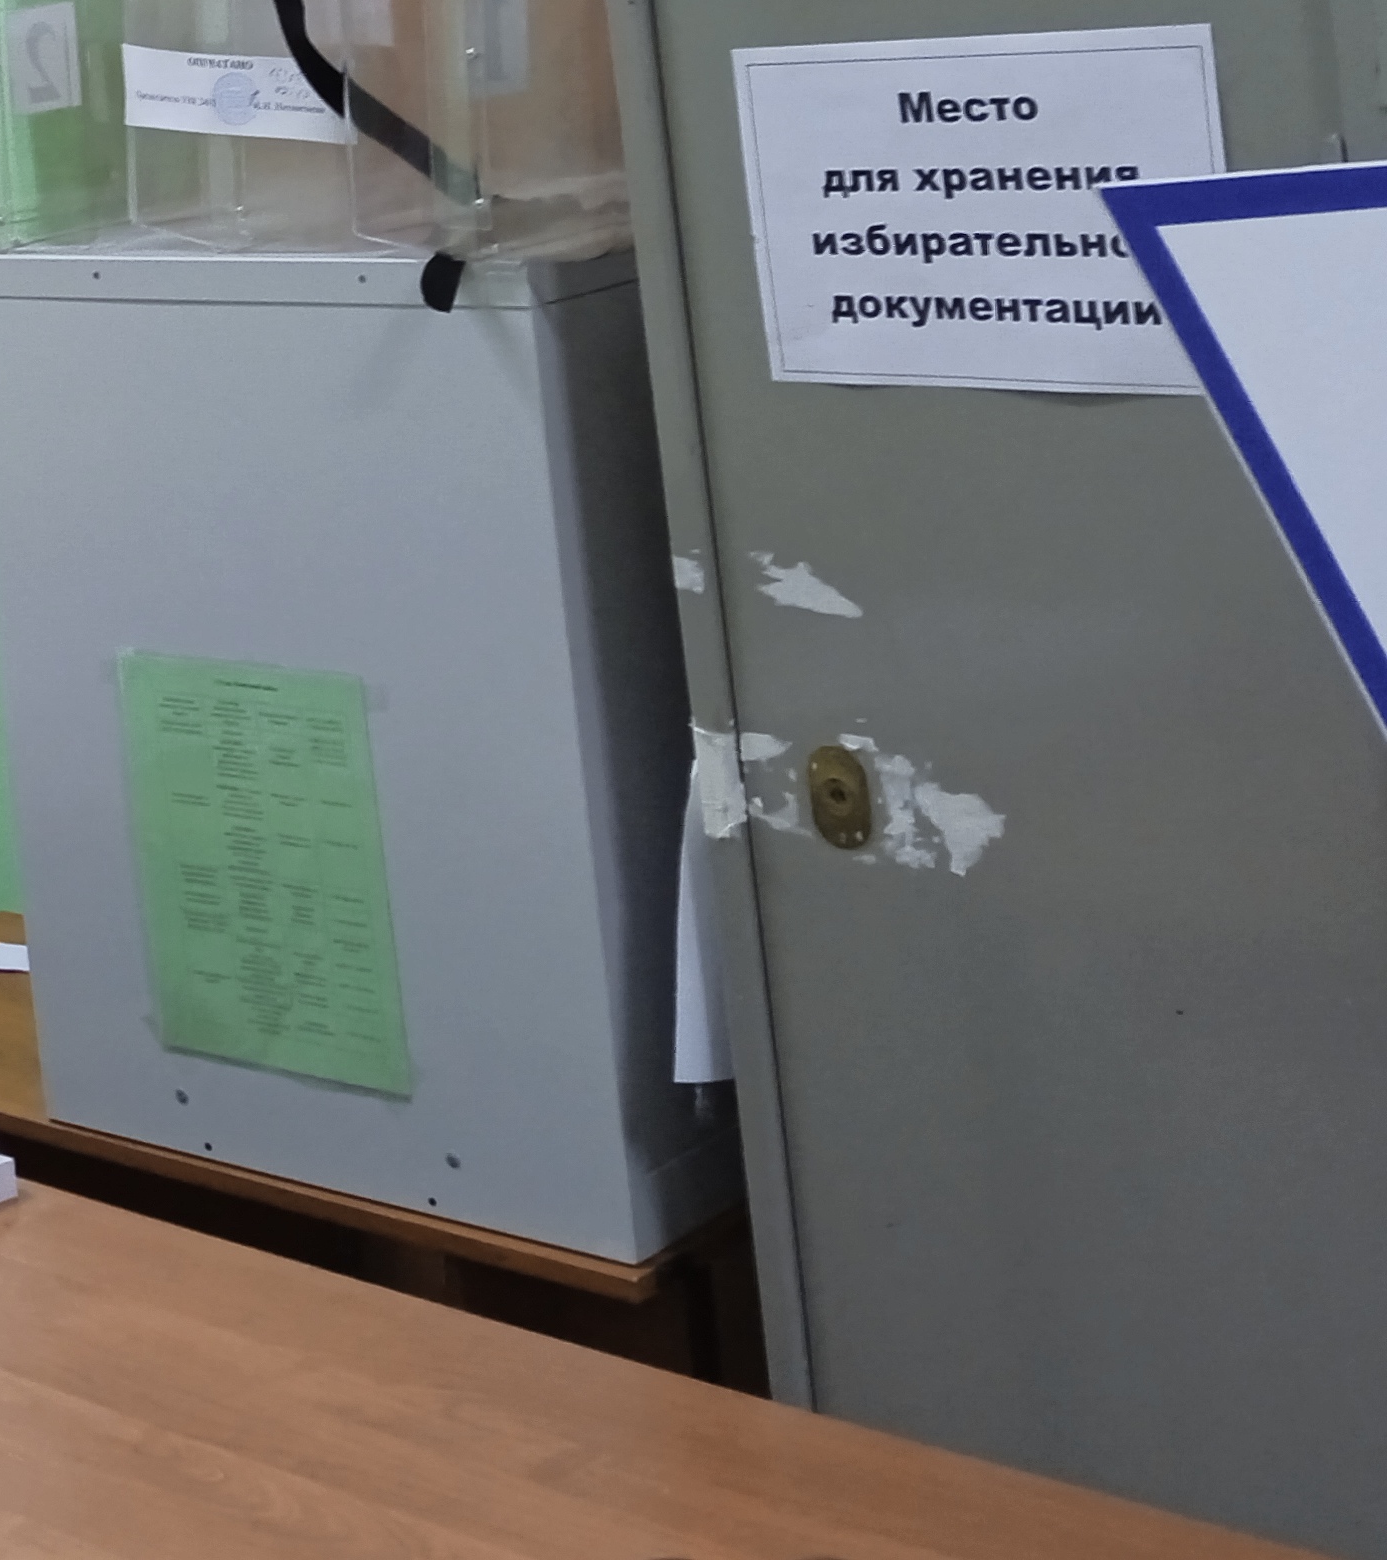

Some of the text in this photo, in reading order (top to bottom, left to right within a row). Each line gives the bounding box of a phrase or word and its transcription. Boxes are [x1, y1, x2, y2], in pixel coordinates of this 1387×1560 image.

[898, 91, 1038, 124] Место
[822, 163, 1139, 199] для хранения
[812, 224, 1129, 263] избирательно
[832, 292, 1163, 328] документации
